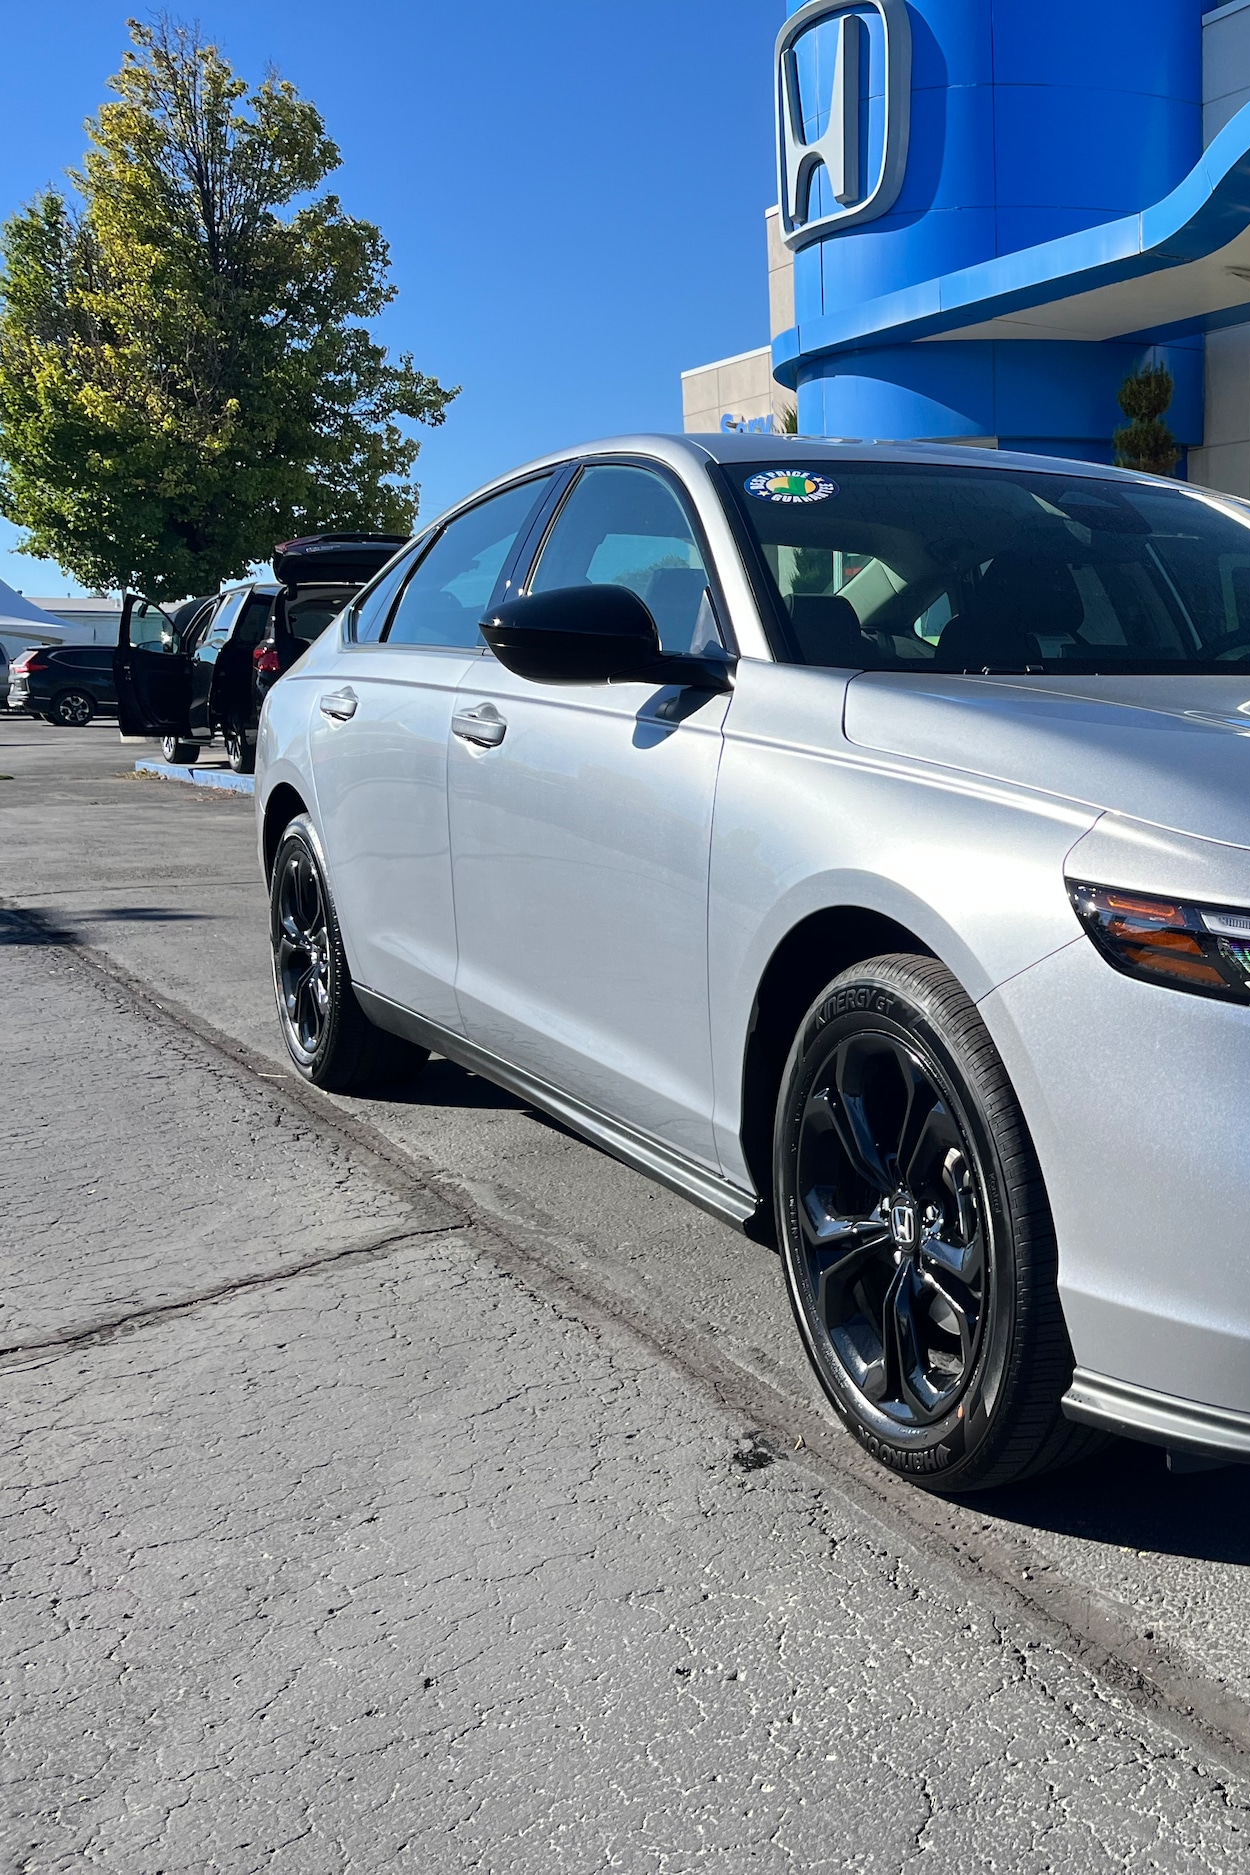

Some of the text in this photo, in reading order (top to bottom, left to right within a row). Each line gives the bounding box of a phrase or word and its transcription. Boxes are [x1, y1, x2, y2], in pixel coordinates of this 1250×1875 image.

[749, 470, 811, 490] BEST PRICE
[771, 483, 835, 503] GUARANTEE
[875, 996, 895, 1015] GT
